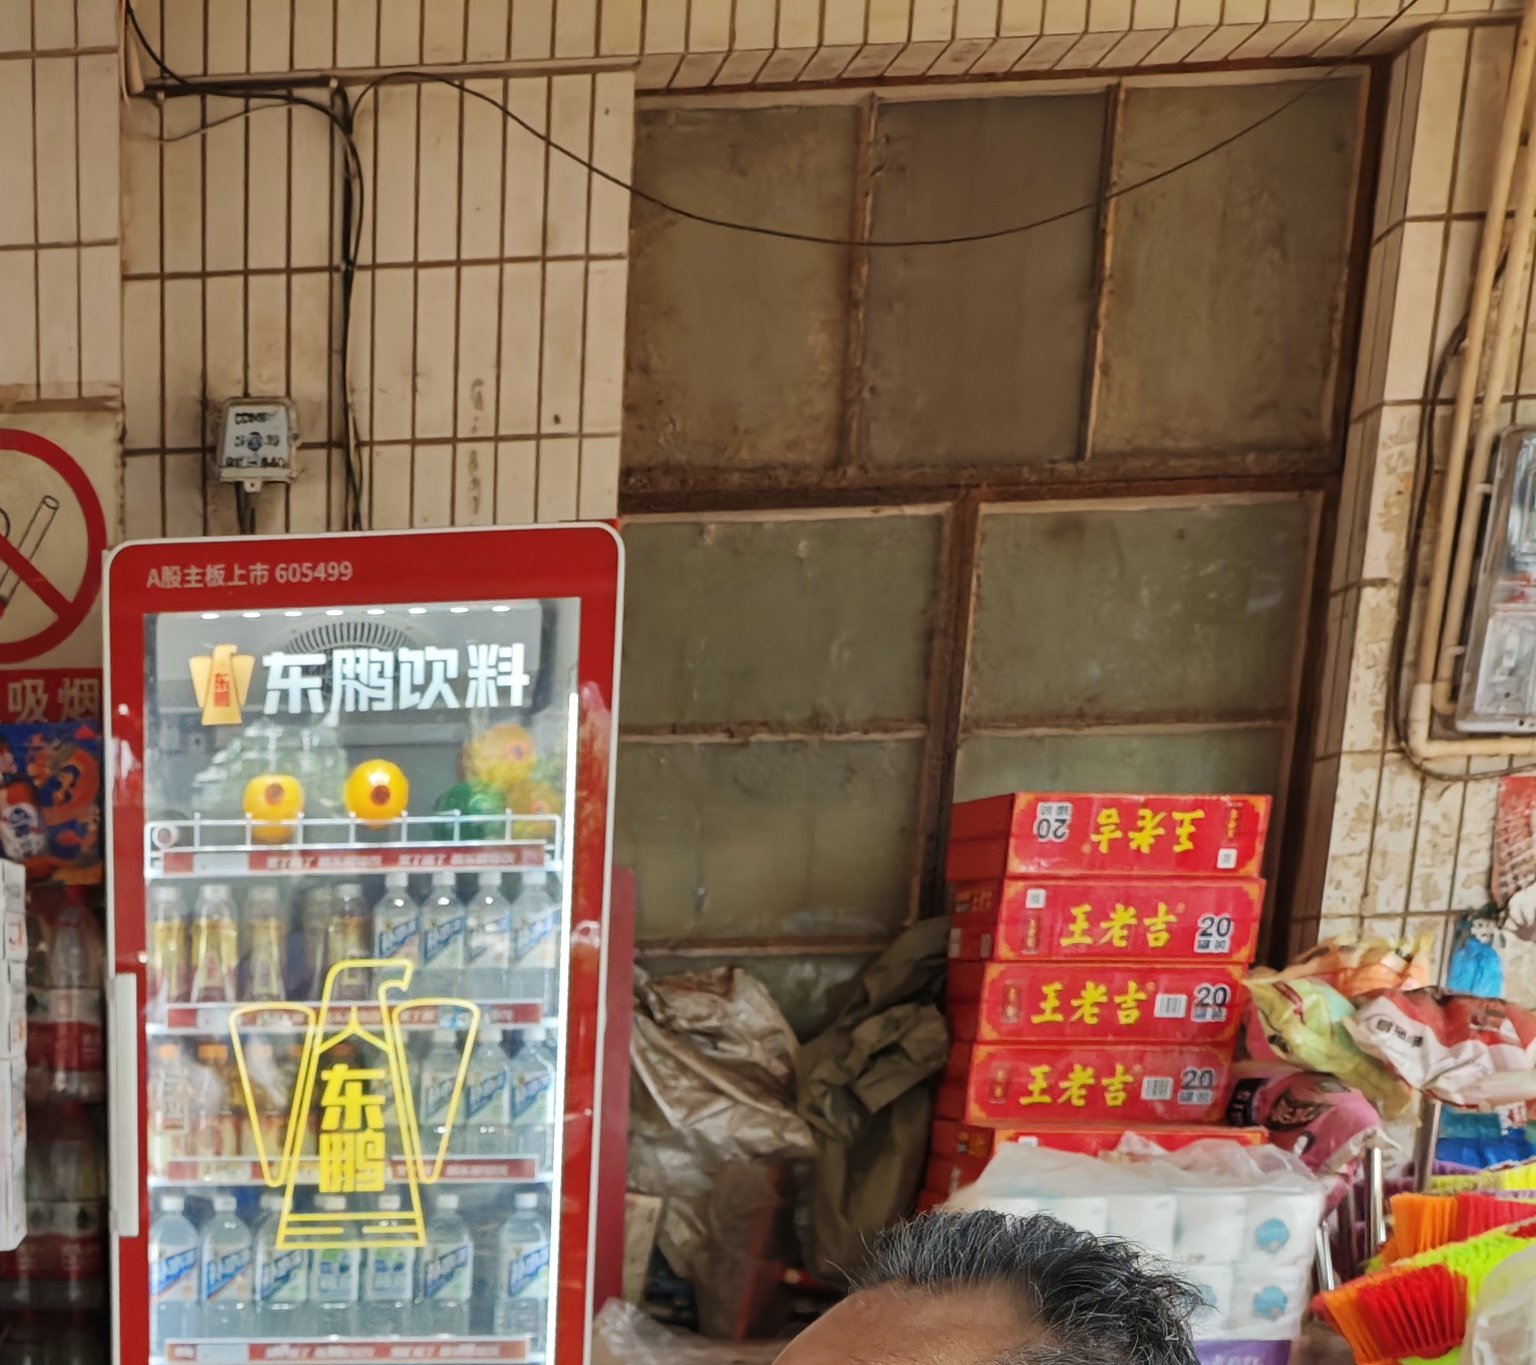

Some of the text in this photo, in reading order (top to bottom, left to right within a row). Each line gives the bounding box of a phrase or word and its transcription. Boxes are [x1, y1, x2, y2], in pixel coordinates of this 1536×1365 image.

[146, 561, 354, 589] A股主板上市 605499
[262, 643, 530, 720] 东鹏饮料
[1036, 818, 1068, 840] 20
[1091, 806, 1206, 854] 王老吉
[1060, 902, 1178, 948] 王老吉
[1198, 916, 1232, 938] 20
[1030, 980, 1147, 1025] 王老吉
[1194, 986, 1227, 1007] 20
[1018, 1064, 1134, 1107] 王老吉
[1181, 1069, 1214, 1090] 20
[318, 1064, 387, 1193] 东鹏
